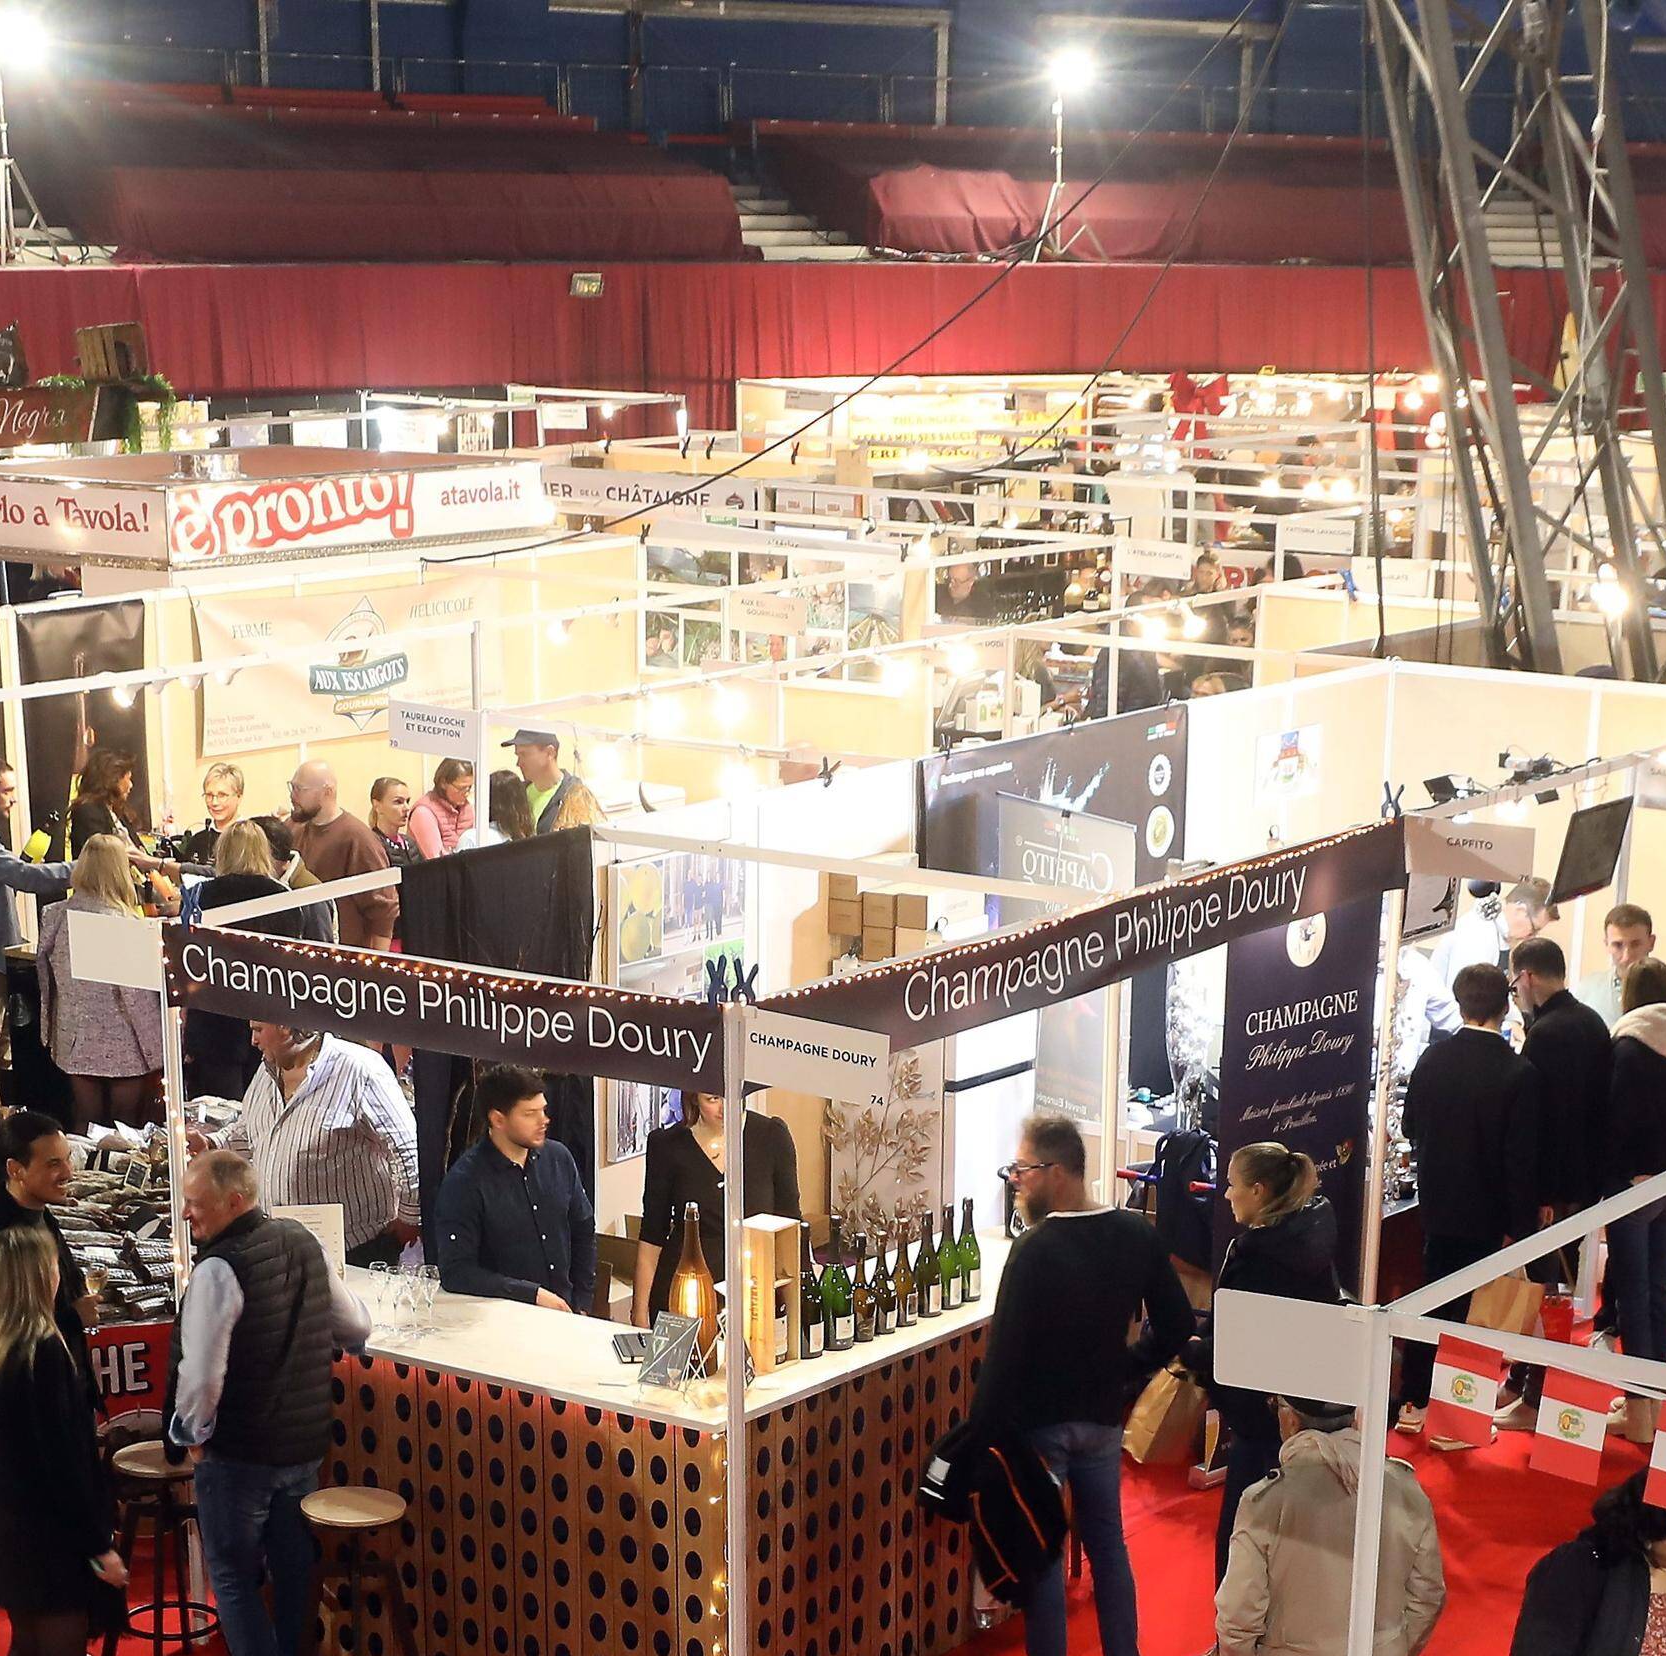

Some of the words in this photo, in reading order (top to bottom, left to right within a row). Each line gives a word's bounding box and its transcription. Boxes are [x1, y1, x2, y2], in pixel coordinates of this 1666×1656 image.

[221, 474, 413, 548] pronto!
[441, 480, 521, 507] atavola.it
[606, 484, 710, 507] CHÂTAIGNE
[33, 509, 49, 526] a
[56, 497, 150, 532] Tavola!
[233, 622, 273, 639] FERME
[313, 669, 339, 691] AUX
[343, 657, 406, 692] ESCARGOTS
[401, 711, 437, 723] TAUREAU
[439, 717, 465, 727] COCHE
[406, 723, 414, 731] ET
[417, 724, 461, 738] EXCEPTION
[1446, 836, 1493, 851] CAPFITO
[903, 932, 1105, 1023] Champagne
[1113, 889, 1223, 964] Philippe
[1228, 864, 1308, 922] Doury
[181, 941, 406, 1019] Champagne
[419, 980, 574, 1048] Philippe
[586, 1006, 713, 1073] Doury
[1245, 990, 1358, 1036] CHAMPAGNE
[750, 1032, 830, 1059] CHAMPAGNE
[831, 1049, 878, 1069] DOURY
[1245, 1040, 1307, 1071] Philippe
[1309, 1029, 1355, 1056] Doury
[871, 1094, 884, 1106] 74
